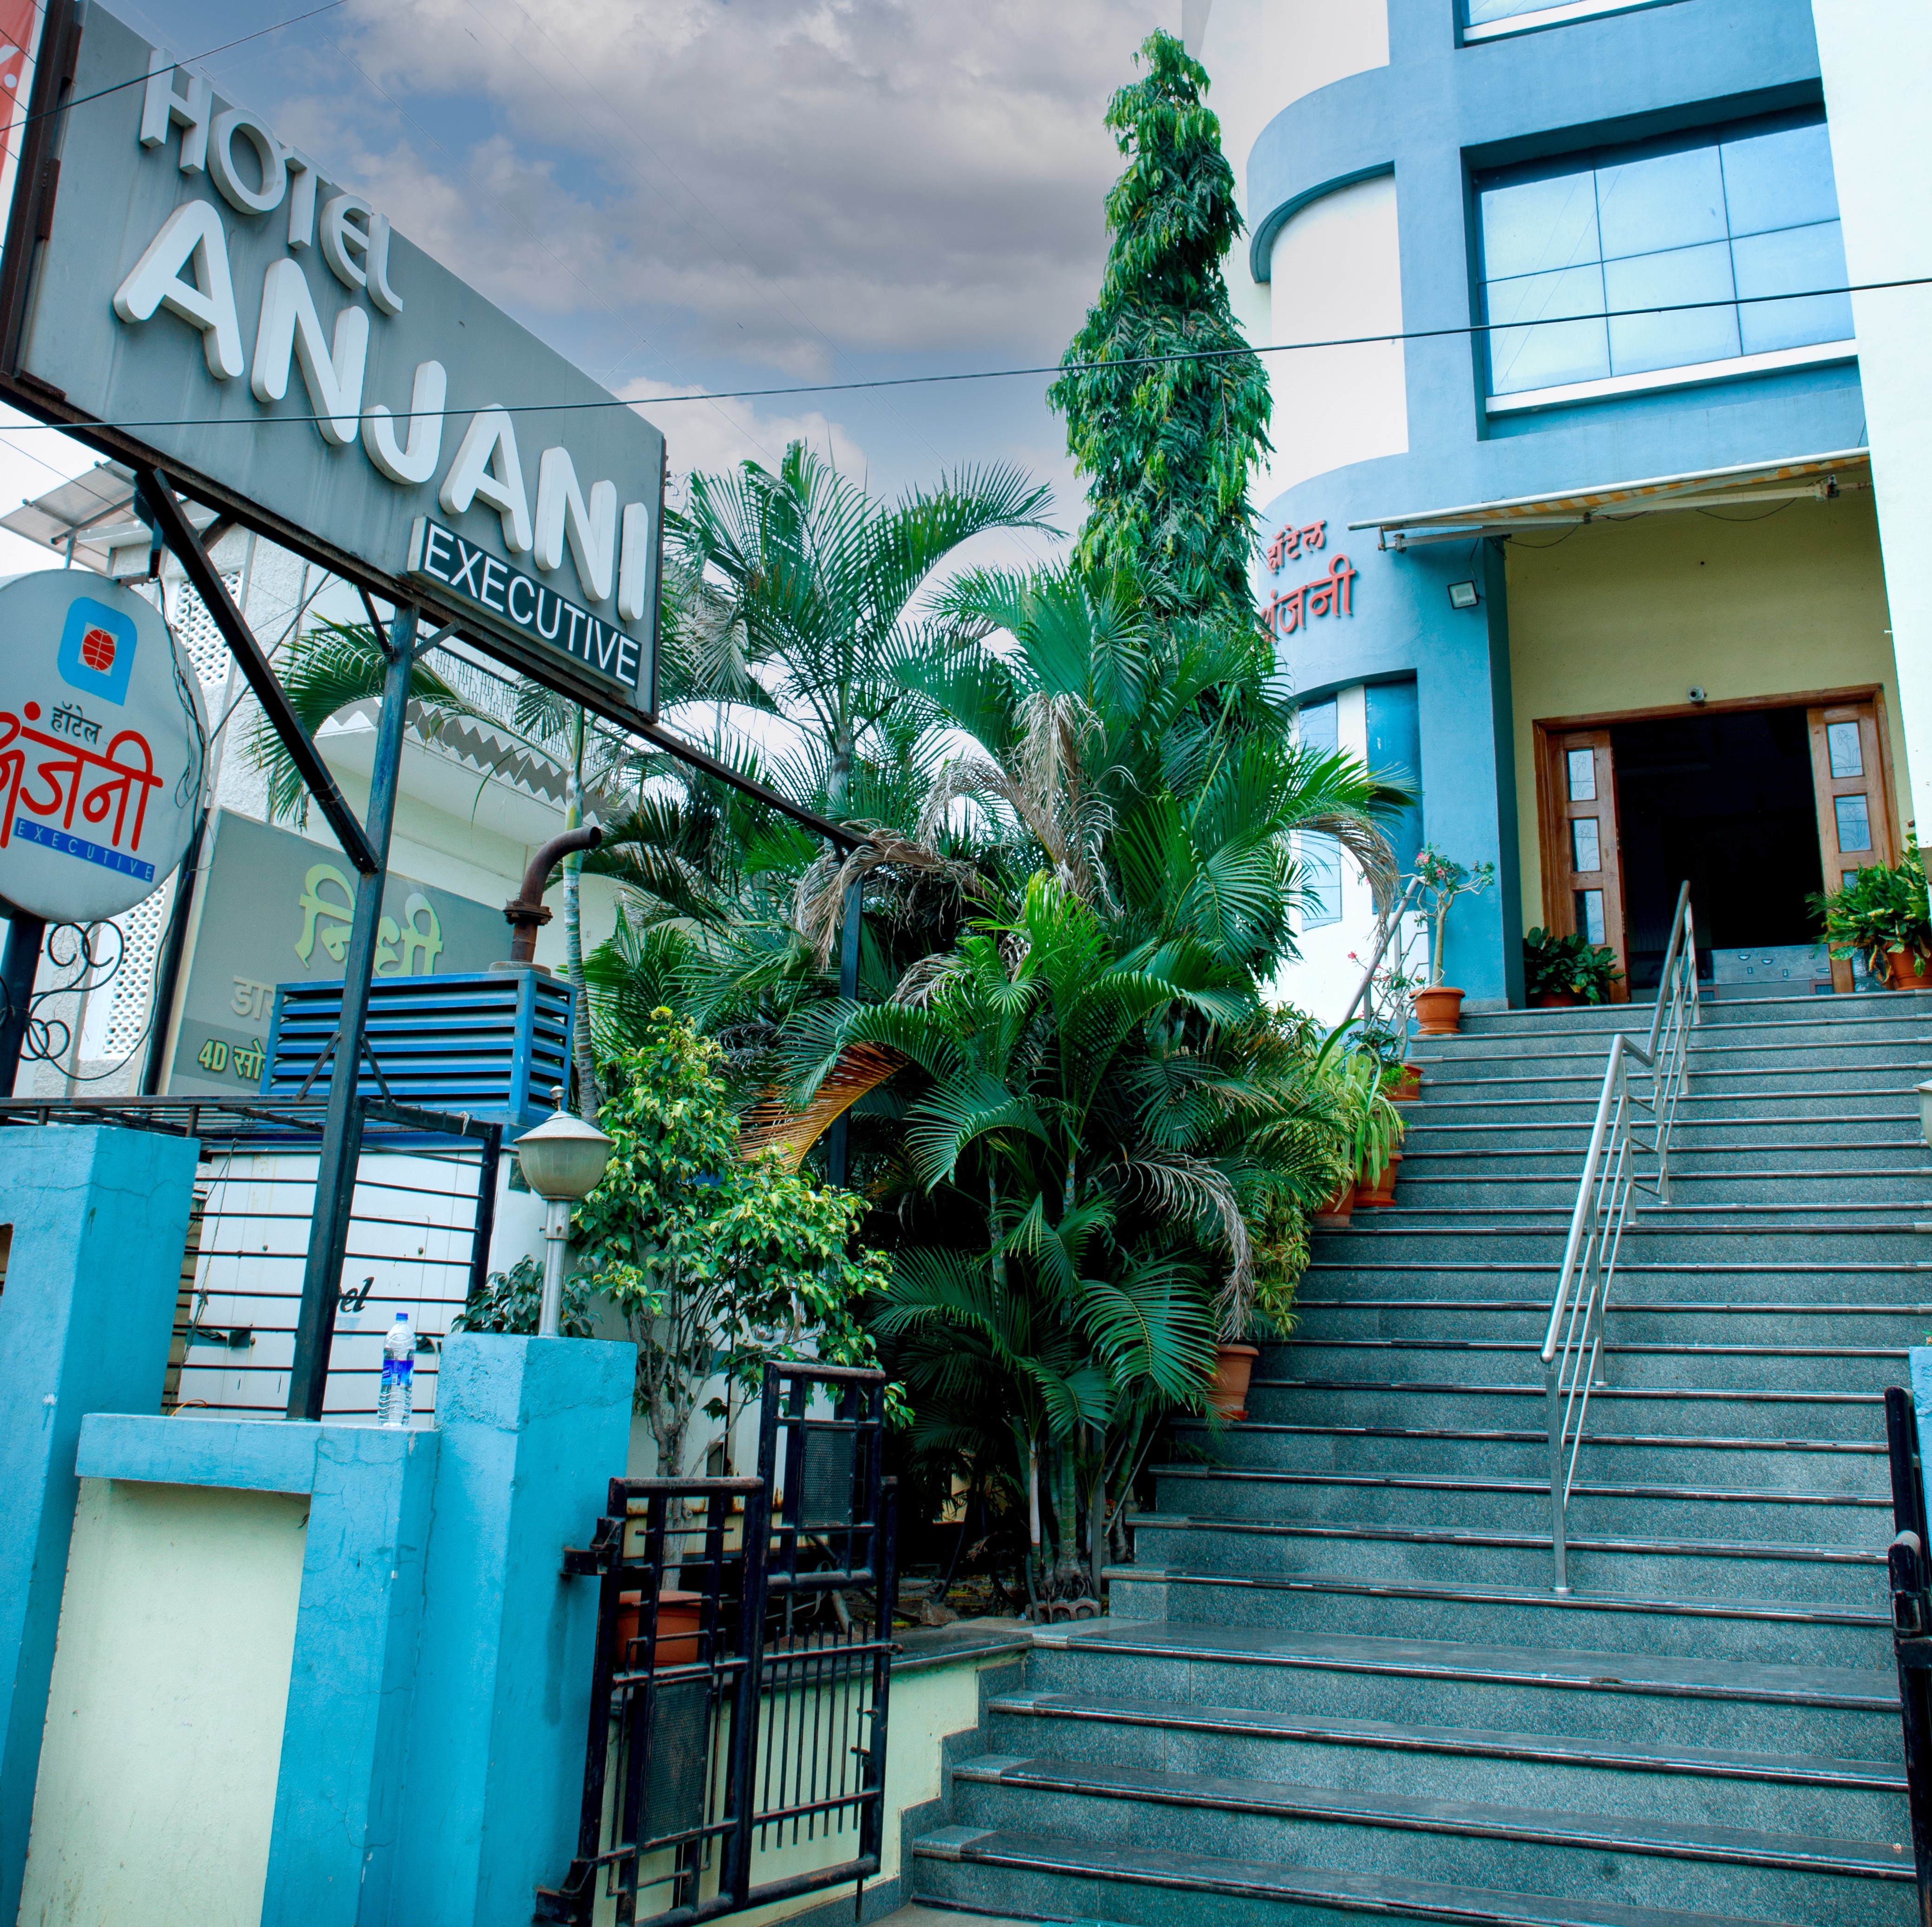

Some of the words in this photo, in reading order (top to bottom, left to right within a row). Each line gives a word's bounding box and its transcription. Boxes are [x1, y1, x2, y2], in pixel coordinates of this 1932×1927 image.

[113, 200, 649, 621] ANJANI
[1266, 520, 1326, 574] हॉटेल
[424, 523, 640, 686] EXECUTIVE
[51, 701, 103, 745] हॉटेल
[18, 820, 153, 880] EXECUTIVE
[198, 1038, 228, 1072] 4D
